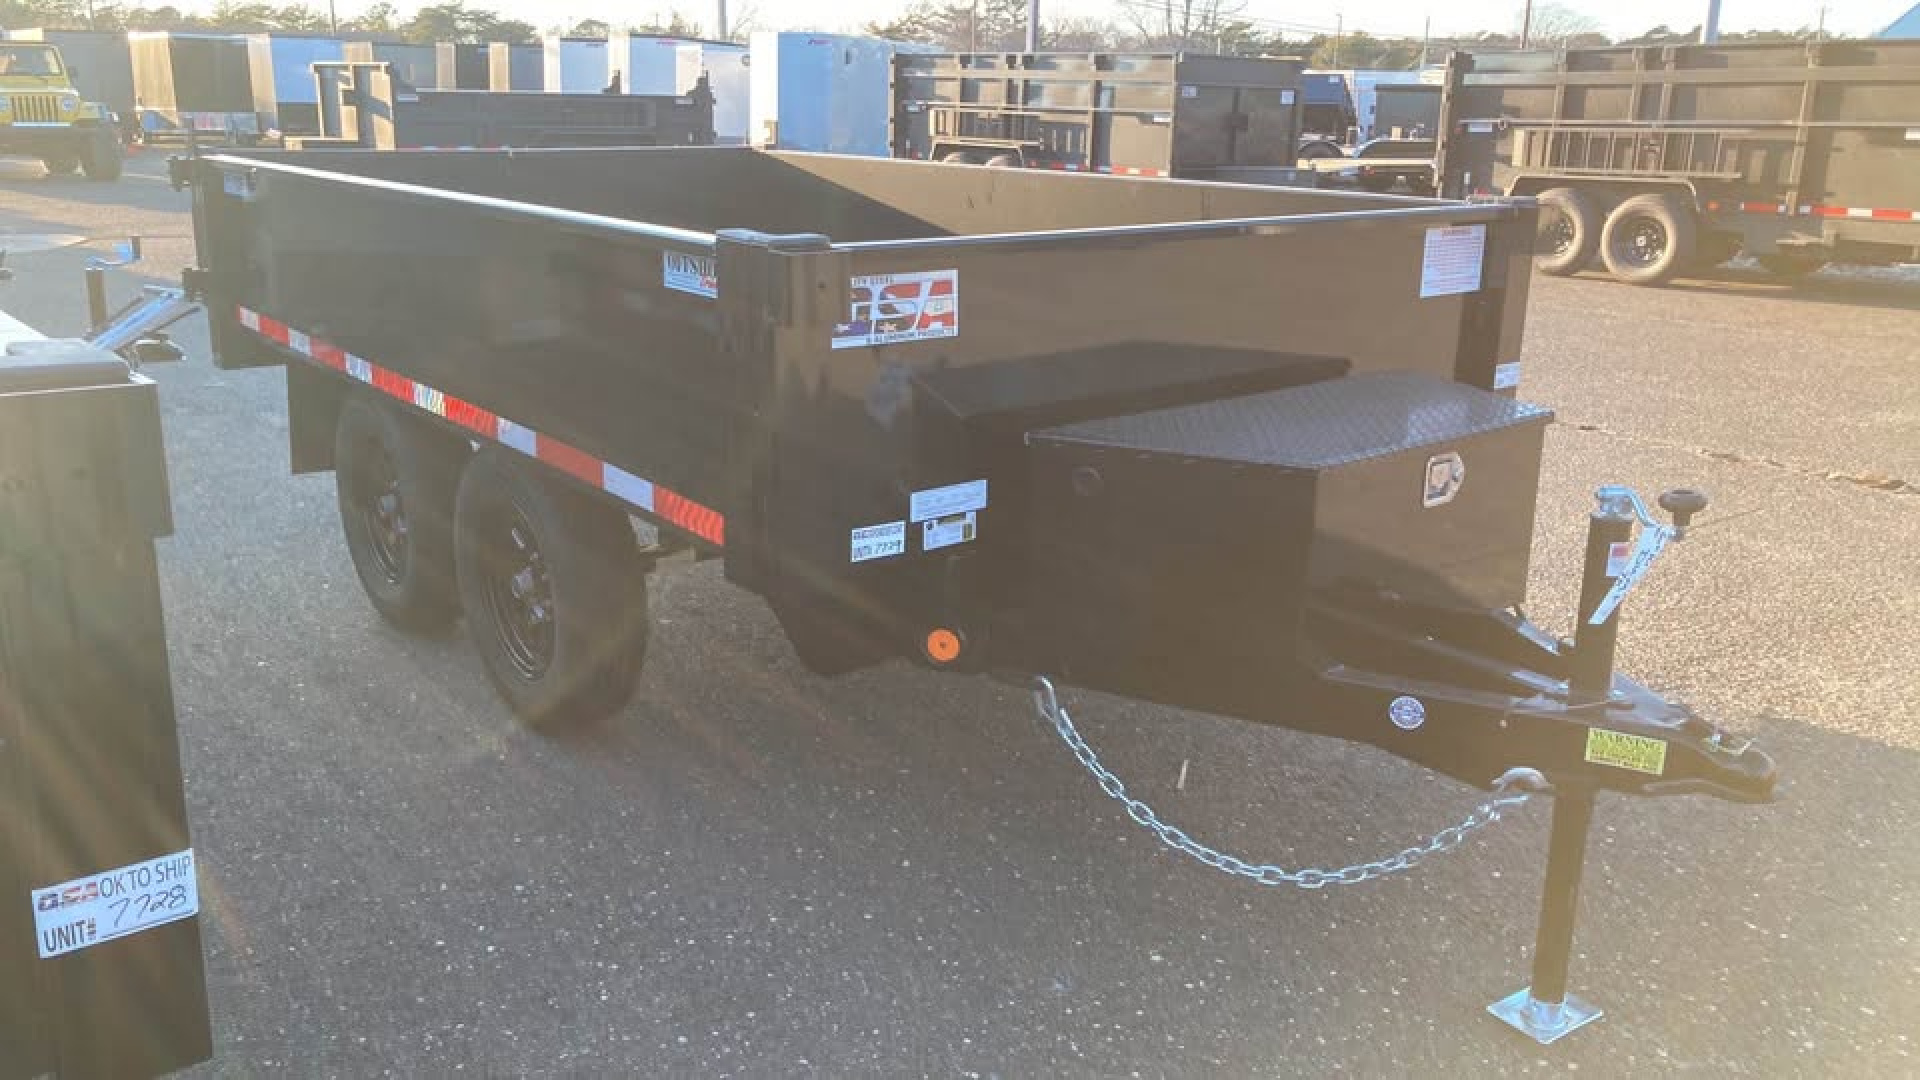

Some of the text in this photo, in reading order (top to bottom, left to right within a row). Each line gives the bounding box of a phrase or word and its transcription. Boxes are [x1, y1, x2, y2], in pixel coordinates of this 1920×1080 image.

[99, 873, 126, 899] OK
[128, 867, 151, 891] TO
[155, 855, 191, 884] SHIP
[107, 883, 187, 929] 7728
